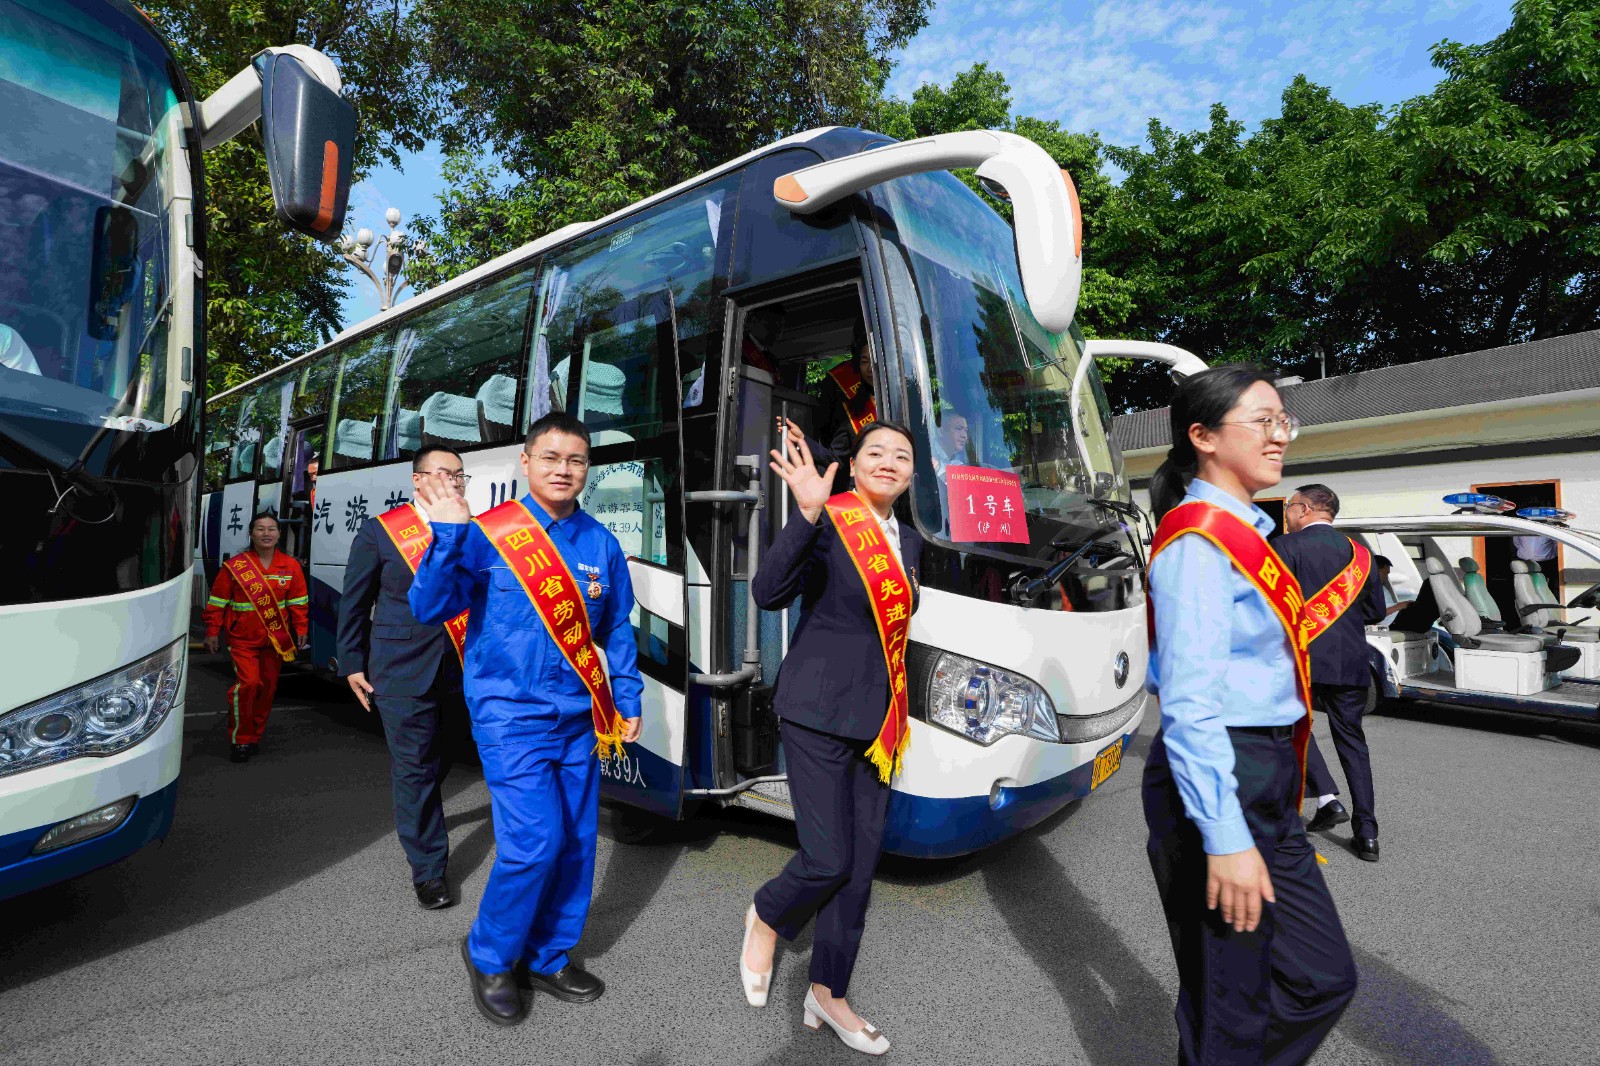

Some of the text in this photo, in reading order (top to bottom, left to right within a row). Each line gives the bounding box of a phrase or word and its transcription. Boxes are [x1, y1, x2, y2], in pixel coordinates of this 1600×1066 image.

[226, 503, 244, 536] 车
[600, 521, 643, 534] 载39人
[966, 494, 1015, 519] 1号车
[232, 559, 282, 632] 全国劳动模范
[505, 527, 604, 690] 四川省劳动模范
[841, 506, 907, 695] 四川省先进工作者
